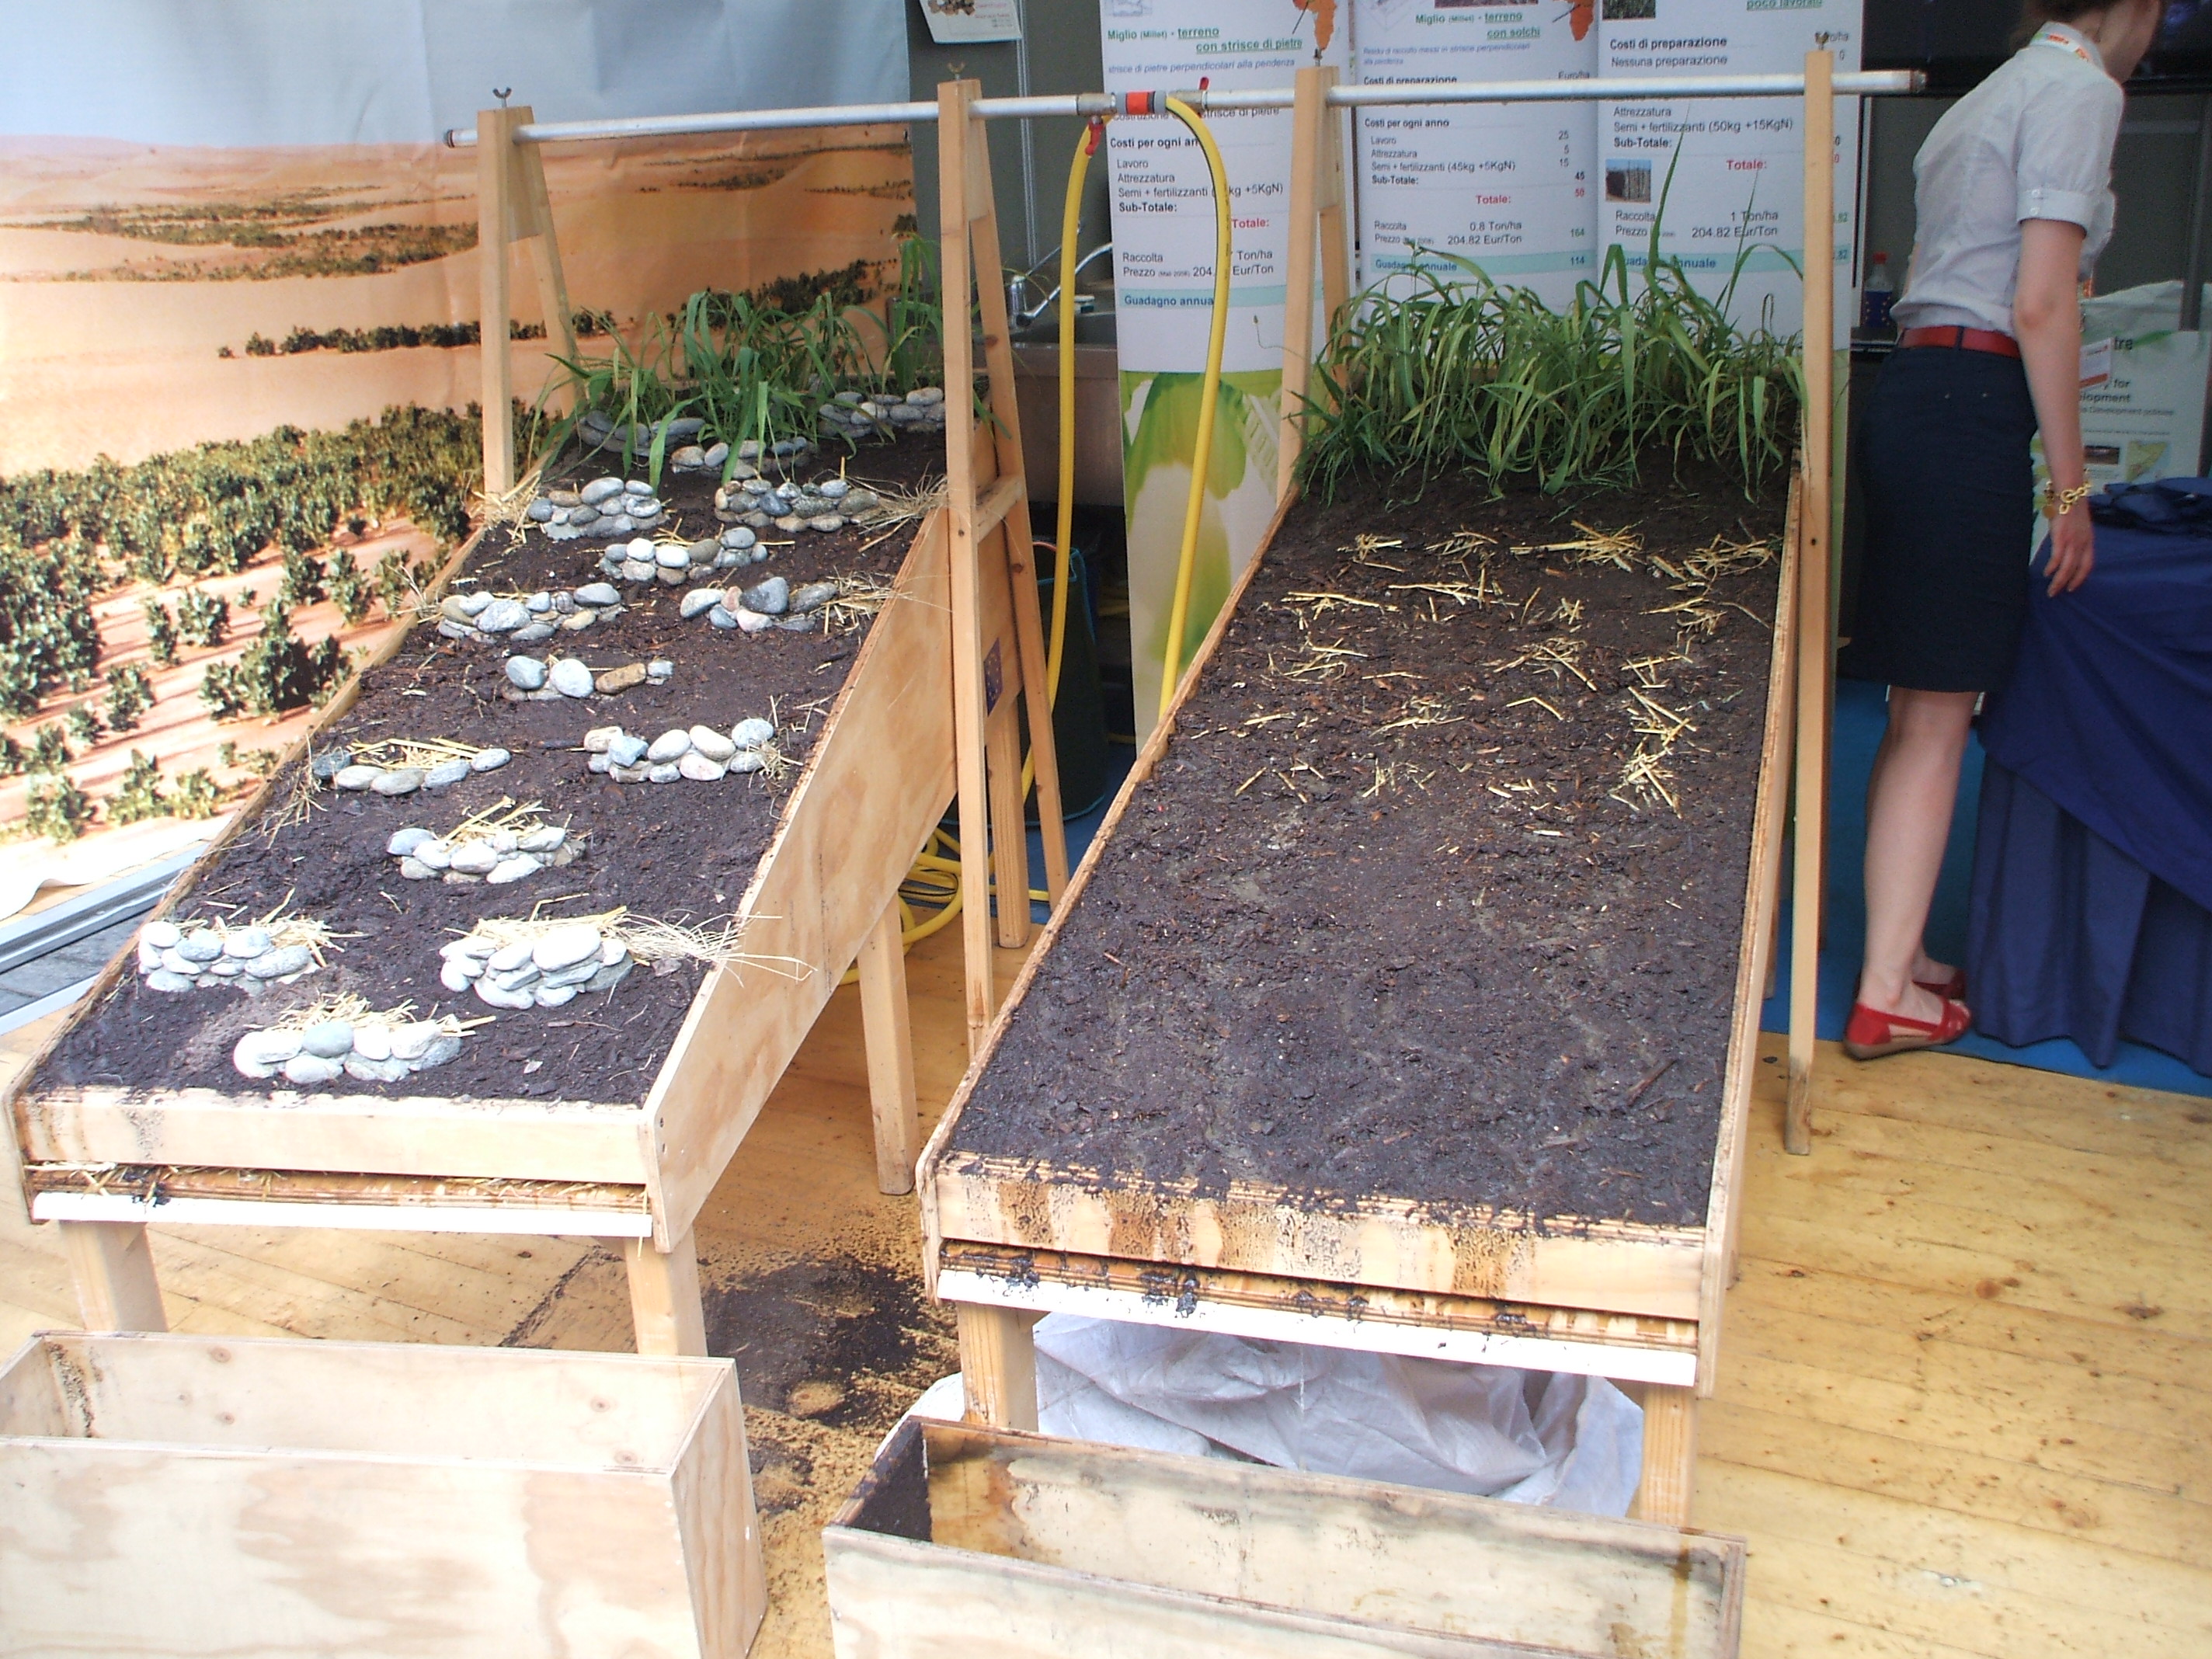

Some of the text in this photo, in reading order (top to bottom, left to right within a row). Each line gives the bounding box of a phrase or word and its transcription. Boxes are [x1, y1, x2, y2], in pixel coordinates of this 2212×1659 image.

[1416, 14, 1445, 25] Miglio
[1485, 12, 1522, 23] terreno
[1108, 30, 1137, 41] Miglio
[1177, 28, 1219, 39] terreno
[1487, 26, 1540, 39] con solchi
[1196, 37, 1303, 54] con strisce di pietre
[1610, 37, 1727, 50] Costi di preparazione
[1144, 64, 1167, 73] pietre
[1170, 61, 1234, 72] perpendicolari
[1255, 58, 1295, 69] pendenza
[1612, 56, 1727, 68] Nessuna preparazione
[1365, 76, 1383, 85] Costi
[1614, 106, 1671, 117] Attrezzatura
[1365, 118, 1384, 127] Costi
[1387, 120, 1400, 128] per
[1403, 119, 1422, 128] ogni
[1614, 122, 1636, 132] Semi
[1650, 121, 1704, 132] fertilizzanti
[1709, 120, 1740, 133] (50kg
[1111, 138, 1134, 148] Costi
[1138, 139, 1153, 149] per
[1157, 137, 1181, 148] ogni
[1371, 136, 1396, 144] Lavoro
[1614, 137, 1671, 148] Sub-Totale:
[1117, 159, 1149, 169] Lavoro
[1727, 160, 1766, 170] Totale:
[1118, 174, 1174, 183] Attrezzatura
[1372, 175, 1418, 185] Sub-Totale:
[1118, 188, 1142, 198] Semi
[1153, 187, 1208, 197] fertilizzanti
[1247, 183, 1283, 196] +5KgN)
[1476, 195, 1511, 204] Totale:
[1119, 202, 1177, 212] Sub-Totale:
[1741, 211, 1778, 221] Ton/ha
[1232, 218, 1269, 228] Totale:
[1489, 221, 1522, 231] Ton/ha
[1616, 225, 1647, 236] Prezzo
[1692, 228, 1730, 238] 204.82
[1375, 234, 1400, 243] Prezzo
[1448, 235, 1480, 245] 204.82
[1484, 235, 1522, 245] Eur/Ton
[1122, 252, 1163, 263] Raccolta
[1237, 250, 1273, 260] Ton/ha
[1123, 266, 1156, 277] Prezzo
[1233, 265, 1274, 276] Eur/Ton
[1125, 295, 1214, 308] Guadagno annua
[2114, 336, 2133, 350] tre
